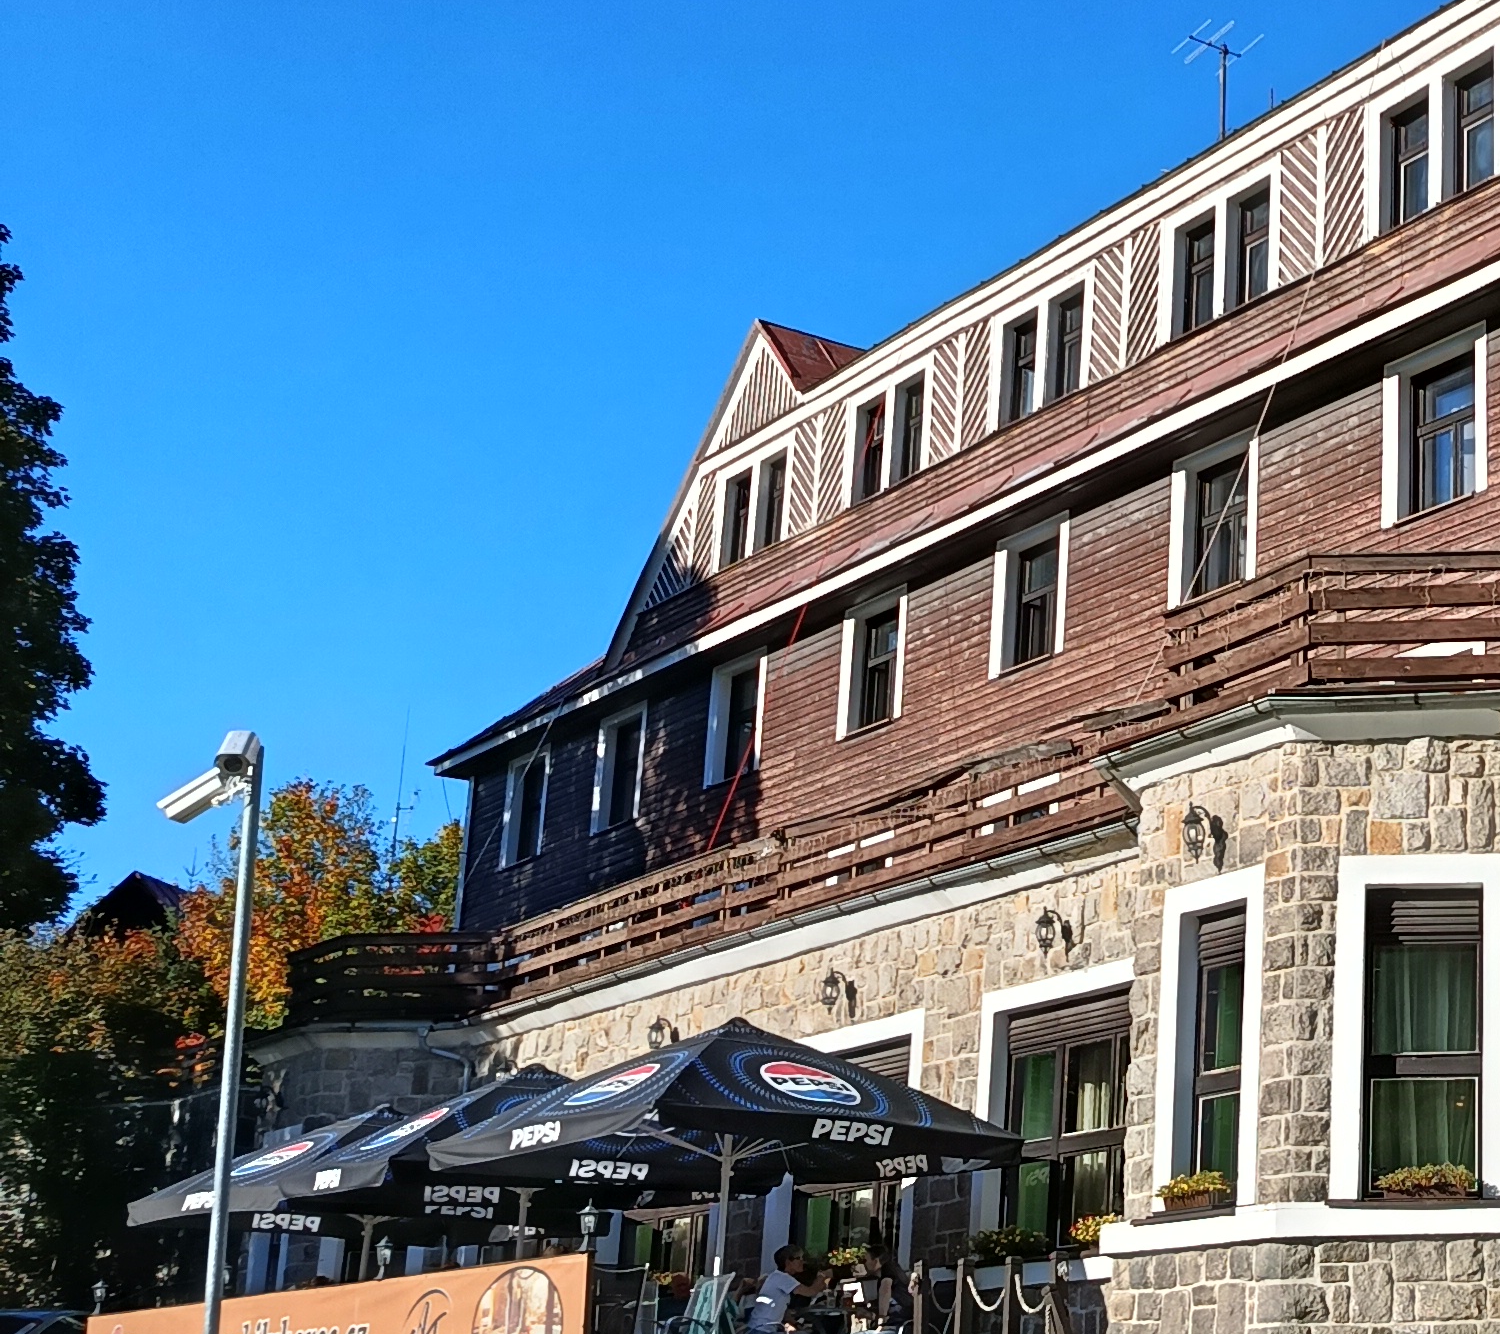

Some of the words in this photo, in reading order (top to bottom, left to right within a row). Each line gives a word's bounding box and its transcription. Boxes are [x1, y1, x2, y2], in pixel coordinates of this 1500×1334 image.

[775, 1075, 853, 1094] PEPSI
[509, 1120, 561, 1150] PEPSI
[812, 1118, 894, 1146] PEPSI
[181, 1190, 216, 1212] PEPS
